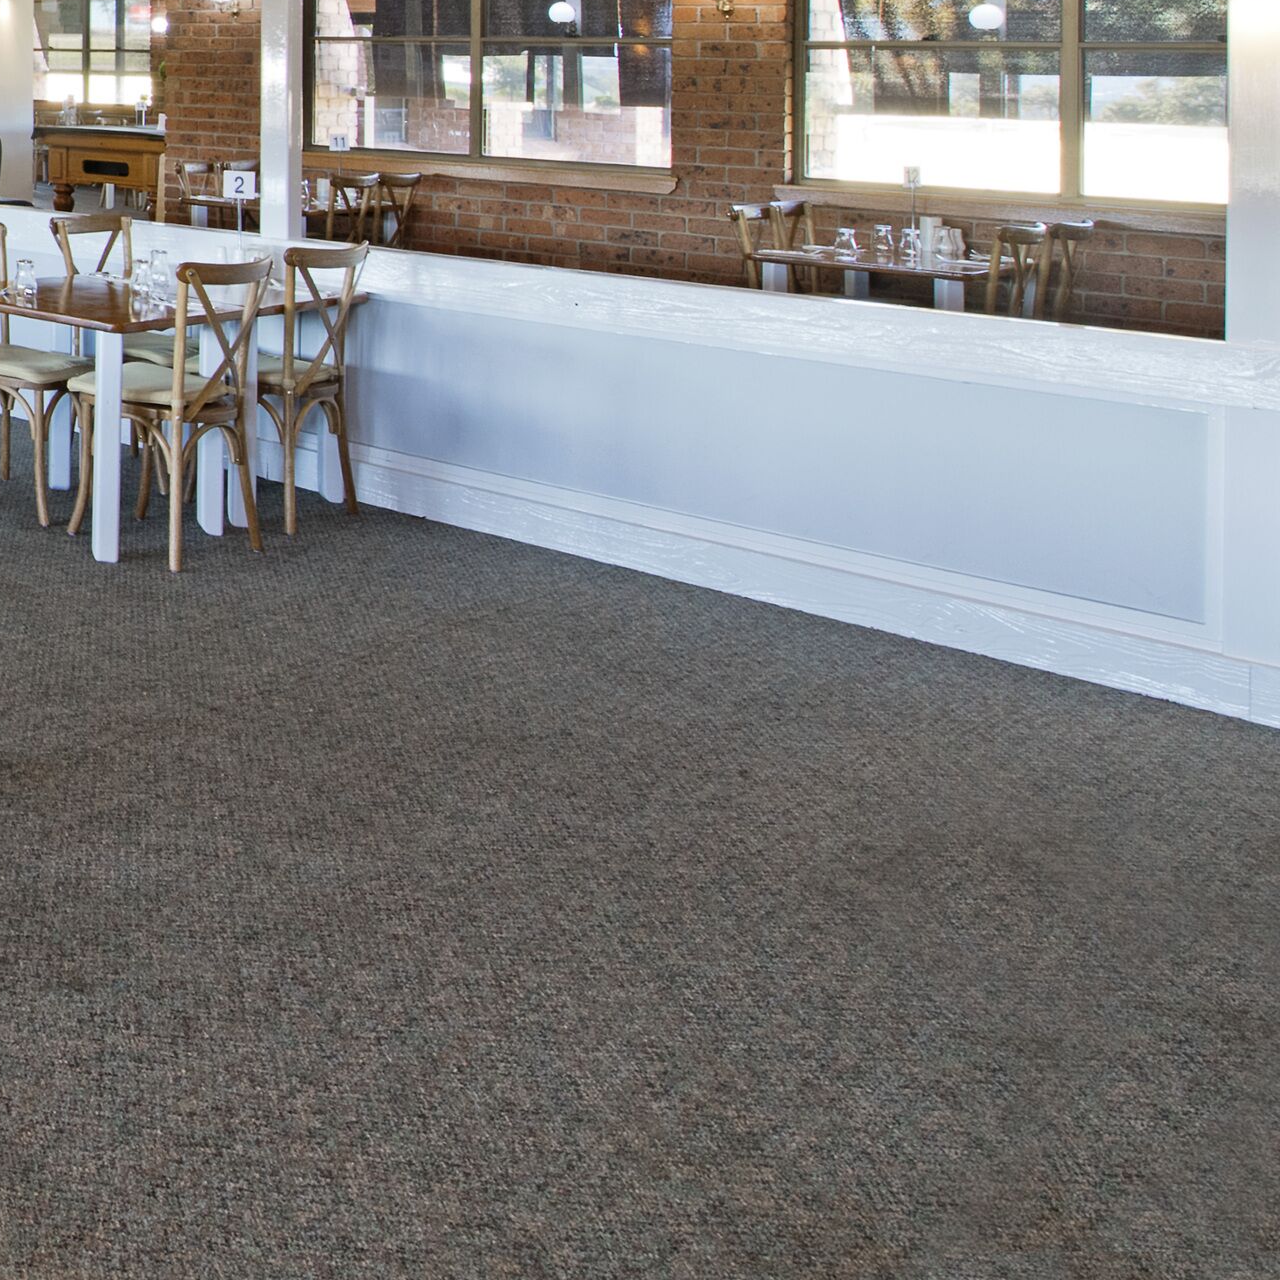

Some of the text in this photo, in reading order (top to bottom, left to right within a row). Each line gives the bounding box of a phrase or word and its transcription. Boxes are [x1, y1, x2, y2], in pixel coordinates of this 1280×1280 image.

[333, 136, 345, 148] 11
[905, 167, 918, 184] 12
[234, 176, 244, 194] 2
